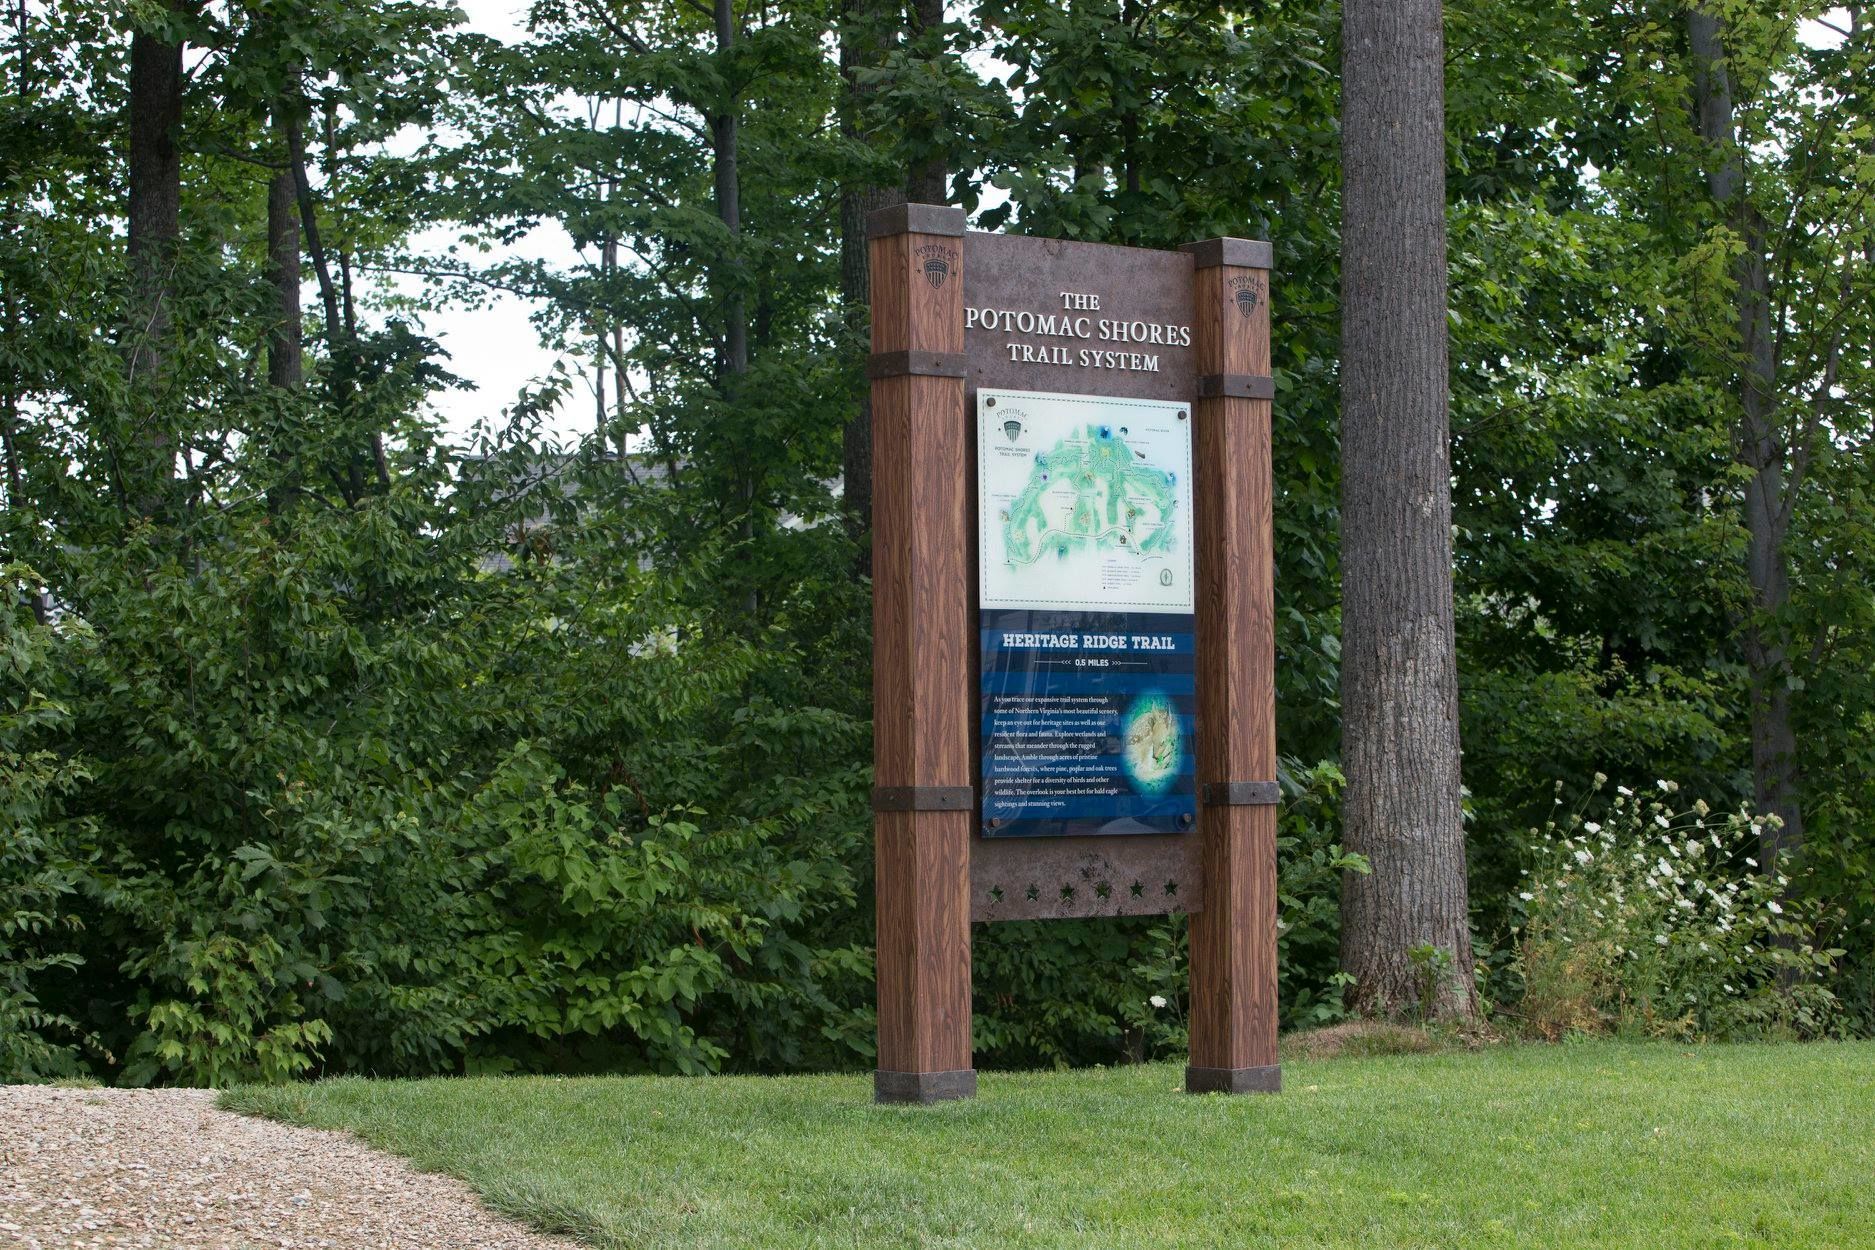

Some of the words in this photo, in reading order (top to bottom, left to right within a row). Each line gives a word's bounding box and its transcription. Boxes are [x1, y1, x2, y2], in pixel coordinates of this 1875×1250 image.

[914, 244, 959, 258] POTOMAC
[1228, 276, 1264, 291] POTOMAC
[1060, 292, 1100, 310] THE
[965, 307, 1090, 338] POTOMAC
[1099, 319, 1191, 347] SHORES
[1006, 344, 1072, 365] TRAIL
[1080, 350, 1160, 372] SYSTEM
[1003, 633, 1078, 648] HERITAGE
[1083, 635, 1128, 649] RIDGE
[1132, 636, 1175, 650] TRAIL
[1075, 658, 1086, 666] 0.5
[1088, 659, 1109, 667] MILES
